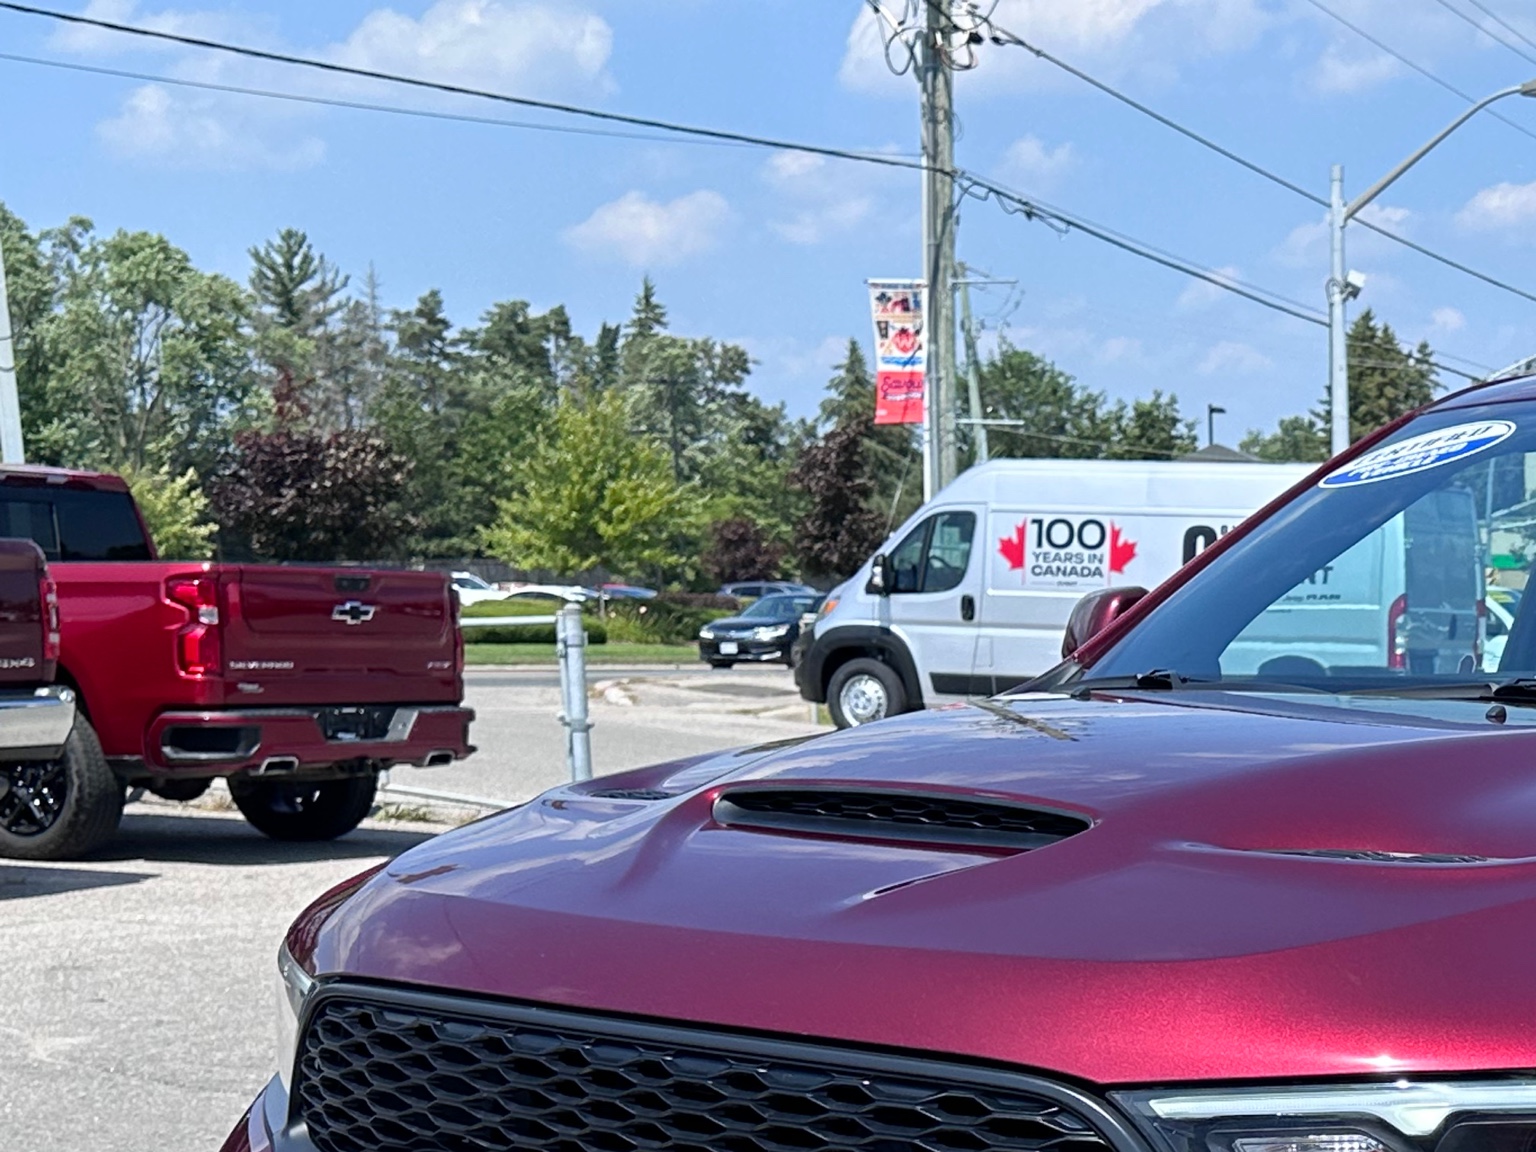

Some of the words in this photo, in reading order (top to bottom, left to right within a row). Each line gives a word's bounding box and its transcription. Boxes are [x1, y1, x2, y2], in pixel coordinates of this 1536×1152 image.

[1030, 518, 1106, 550] 100
[1032, 551, 1085, 564] YEARS
[1087, 553, 1104, 565] IN
[1031, 565, 1104, 578] CANADA
